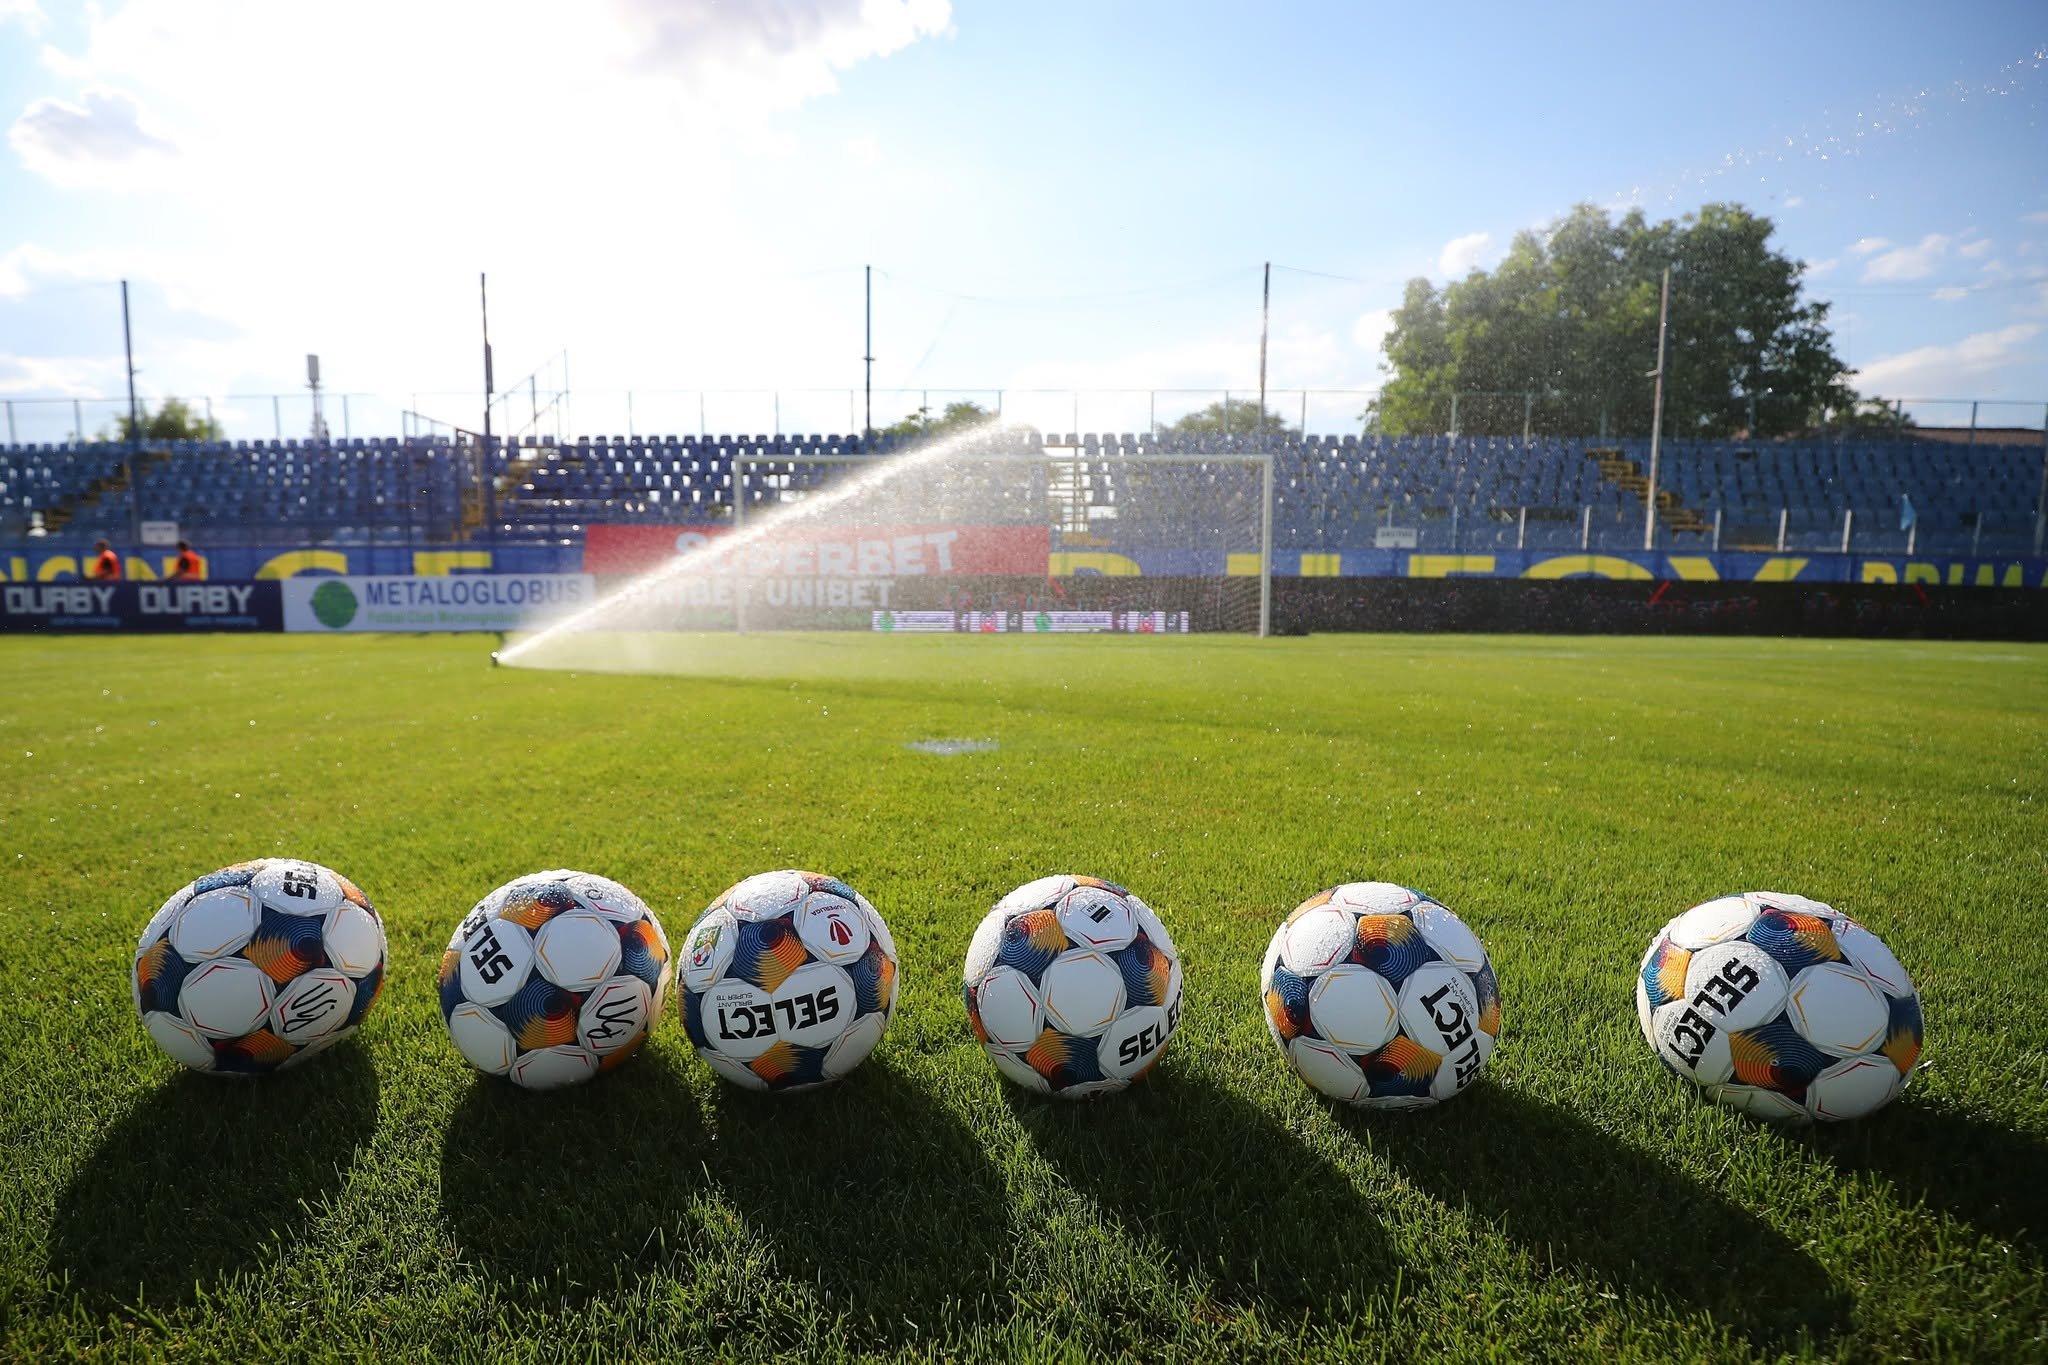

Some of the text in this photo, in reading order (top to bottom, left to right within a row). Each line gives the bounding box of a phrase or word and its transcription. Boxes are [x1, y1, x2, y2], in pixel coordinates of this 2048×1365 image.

[365, 580, 582, 606] METALOGLOBUS
[766, 578, 896, 607] UNIBET
[717, 1000, 753, 1008] BRILLANT
[727, 992, 753, 1001] SUPER
[718, 985, 840, 1040] SELECT
[1119, 978, 1183, 1067] SELEC
[1668, 957, 1760, 1070] SELECT
